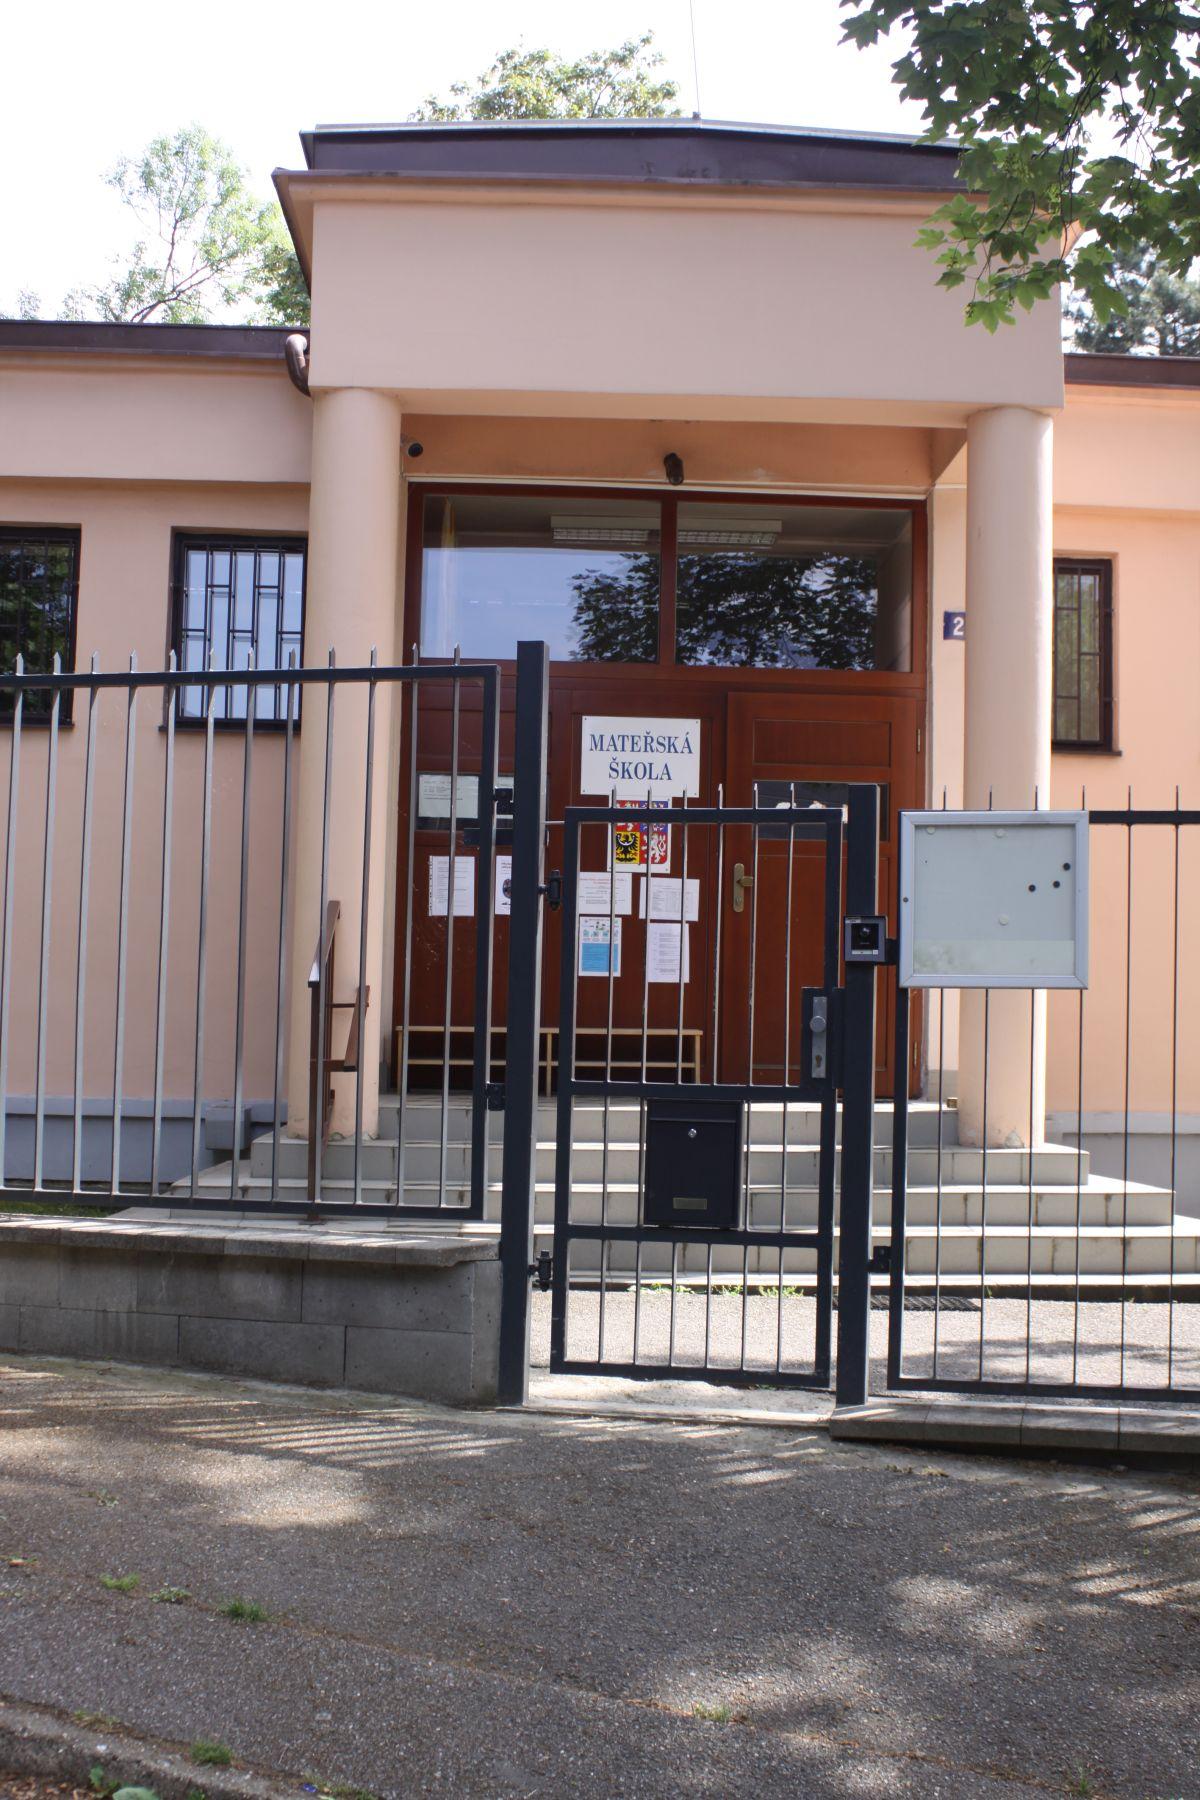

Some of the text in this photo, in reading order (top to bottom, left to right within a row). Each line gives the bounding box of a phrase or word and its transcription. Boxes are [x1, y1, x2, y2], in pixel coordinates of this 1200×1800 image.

[953, 616, 965, 636] 2
[589, 730, 693, 754] MATEŘSKÁ
[608, 756, 673, 781] ŠKOLA
